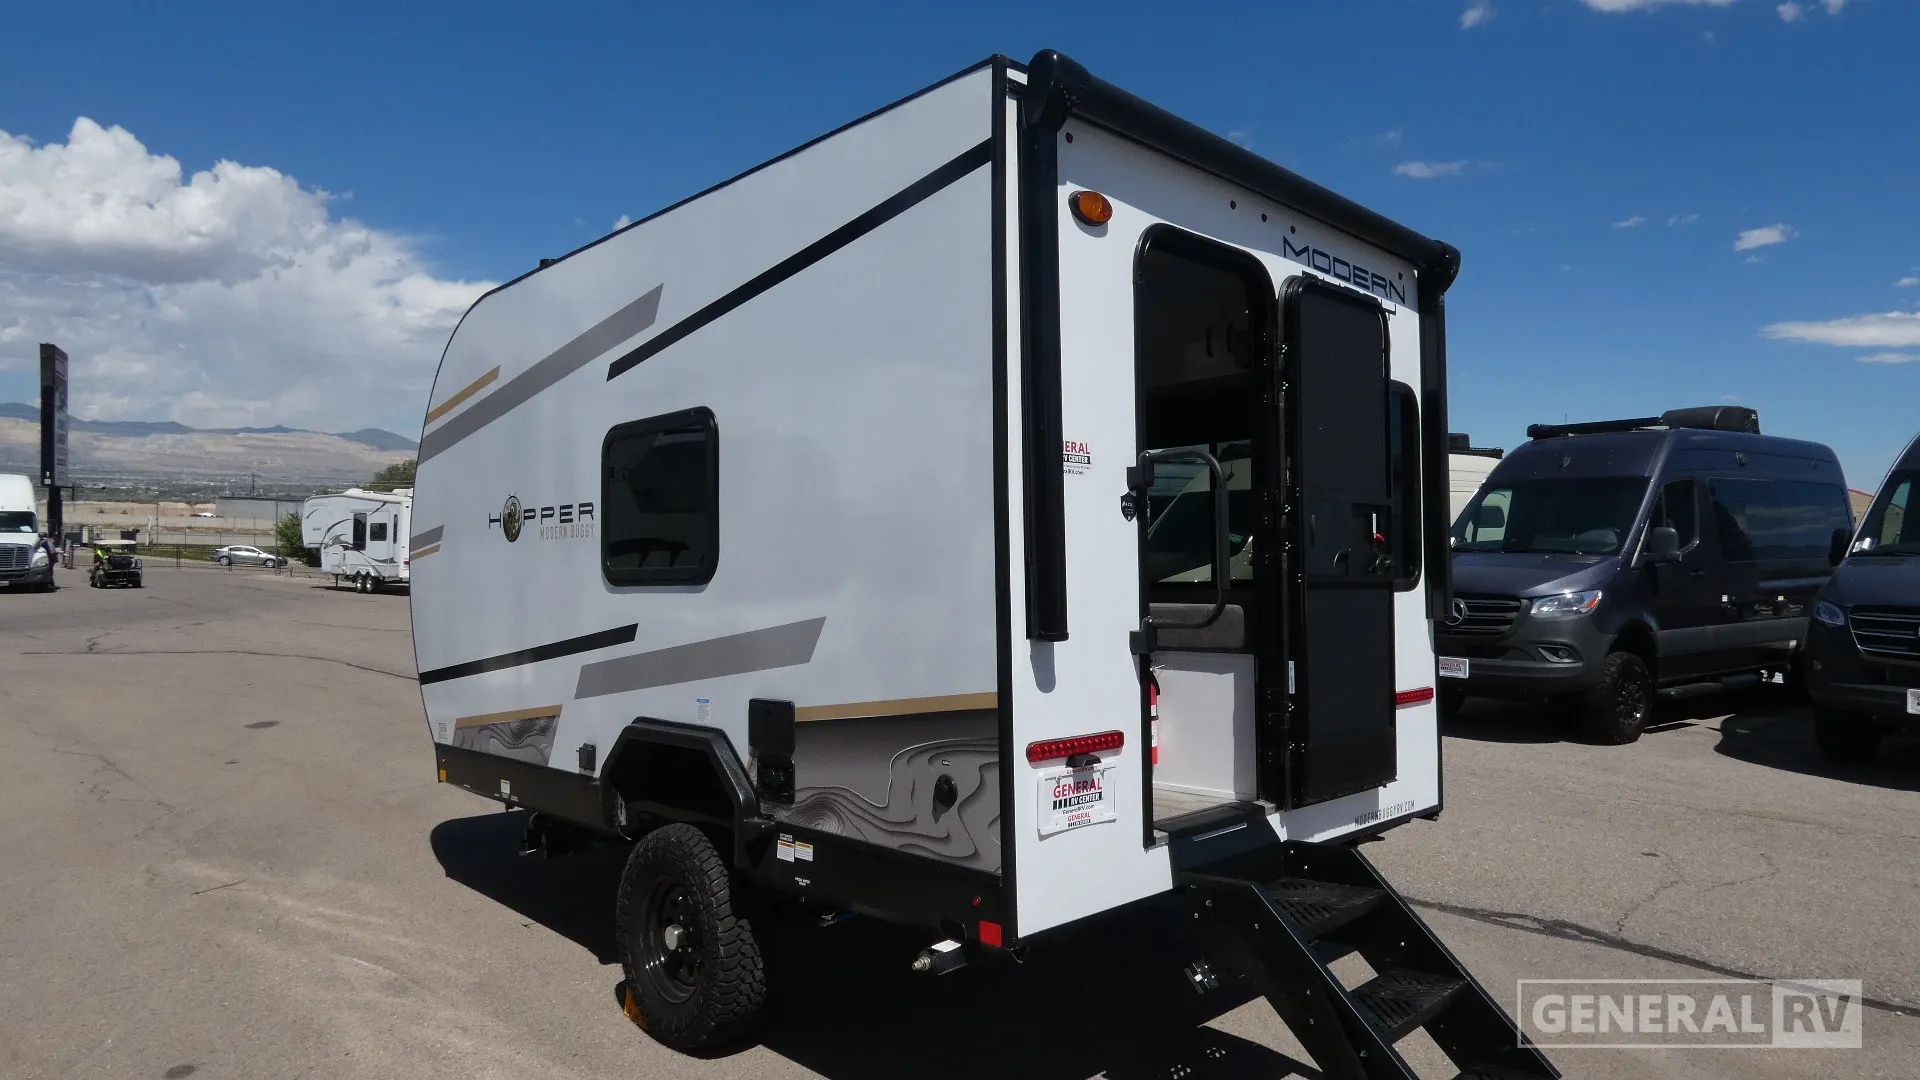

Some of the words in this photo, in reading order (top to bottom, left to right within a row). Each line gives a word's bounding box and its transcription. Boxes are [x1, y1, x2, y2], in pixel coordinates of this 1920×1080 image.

[1283, 235, 1405, 304] MODERN
[1064, 441, 1090, 454] ERAL
[488, 495, 595, 542] HOPPER
[540, 525, 568, 540] MODERN
[571, 522, 595, 538] BUGGY
[1053, 778, 1102, 798] GENERAL
[1070, 796, 1080, 806] RV
[1079, 792, 1100, 804] CENTER
[1068, 812, 1090, 821] GENERAL
